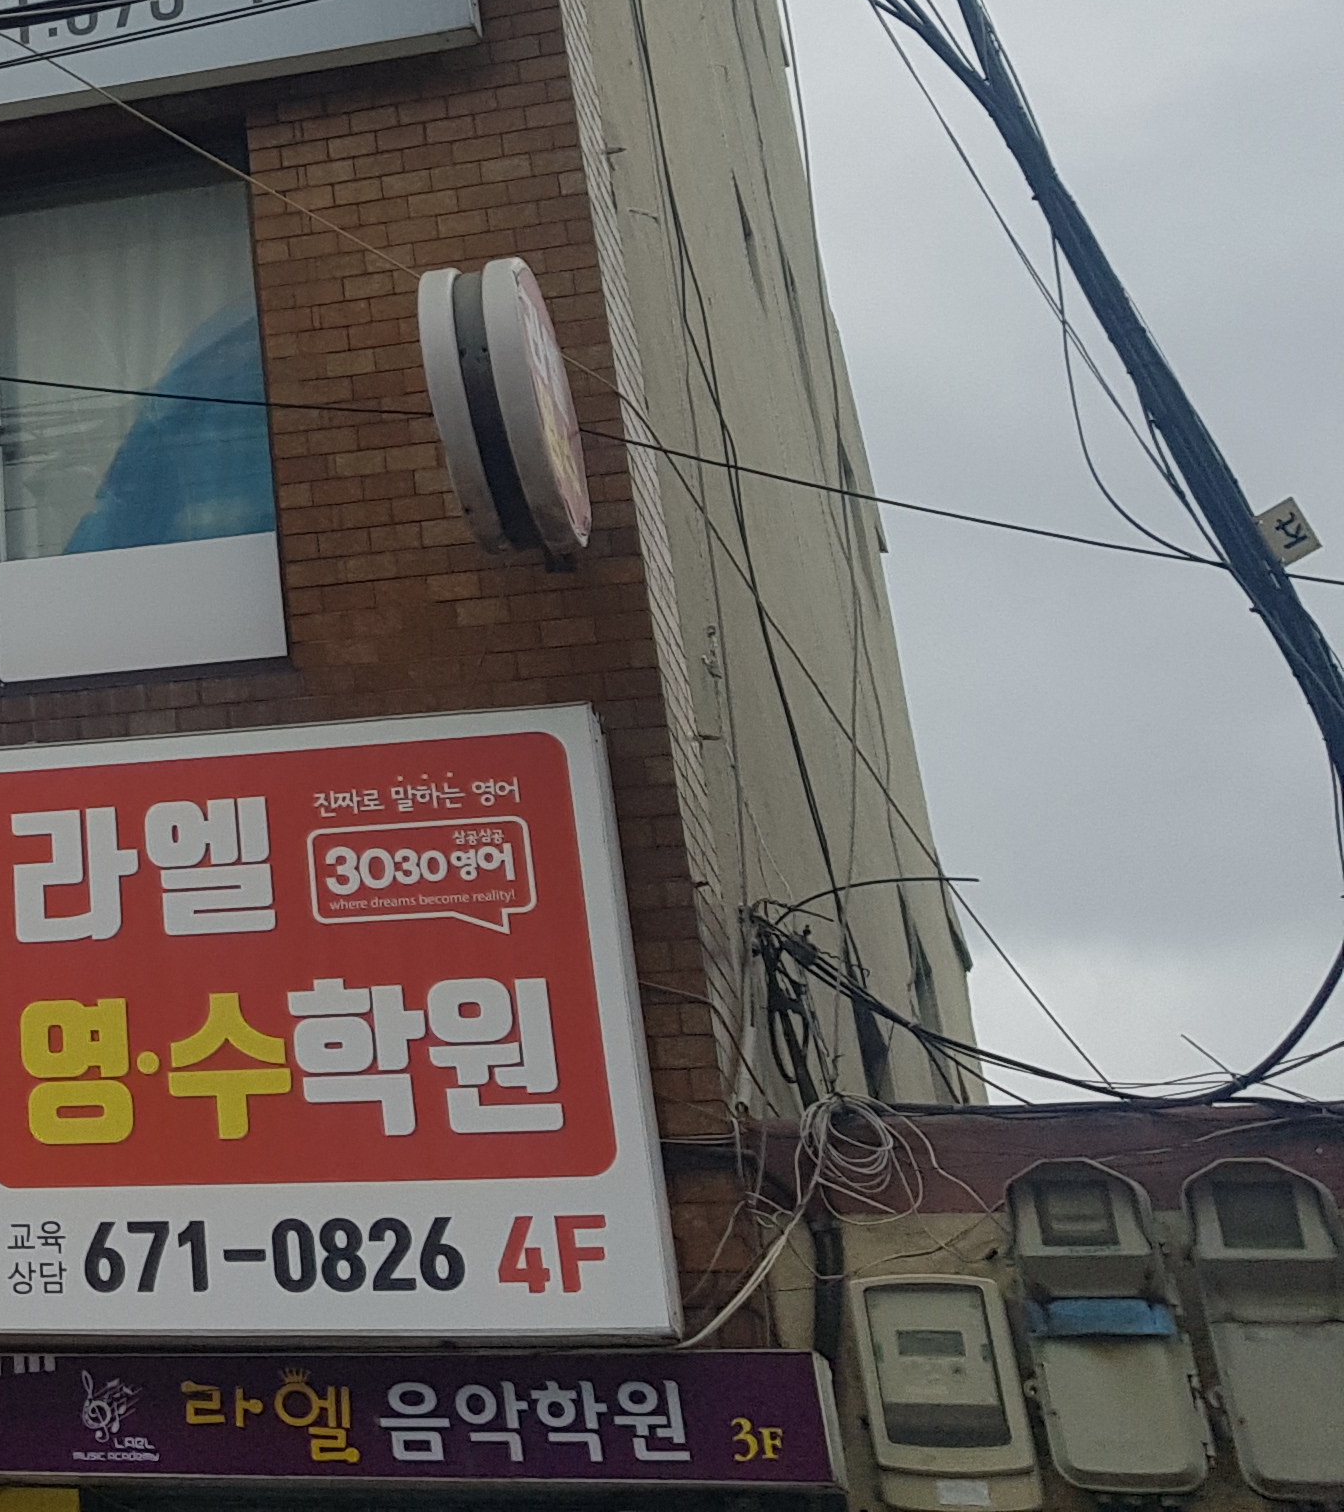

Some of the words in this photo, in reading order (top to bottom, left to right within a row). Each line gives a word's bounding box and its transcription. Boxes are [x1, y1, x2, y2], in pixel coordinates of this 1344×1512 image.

[313, 790, 385, 818] 진짜로
[391, 779, 466, 813] 말하는
[471, 776, 521, 806] 영어
[452, 828, 505, 845] 삼공삼공
[10, 795, 277, 944] 라엘
[329, 898, 368, 911] where
[370, 895, 417, 908] dreams
[419, 891, 470, 905] become
[472, 888, 516, 904] reality!
[6, 1220, 67, 1255] 교육
[83, 1216, 466, 1294] 671-0826
[498, 1214, 607, 1294] 4F
[6, 1262, 67, 1295] 상담
[180, 1378, 360, 1463] 라엘
[379, 1378, 692, 1464] 음악학원
[730, 1417, 785, 1464] 3F
